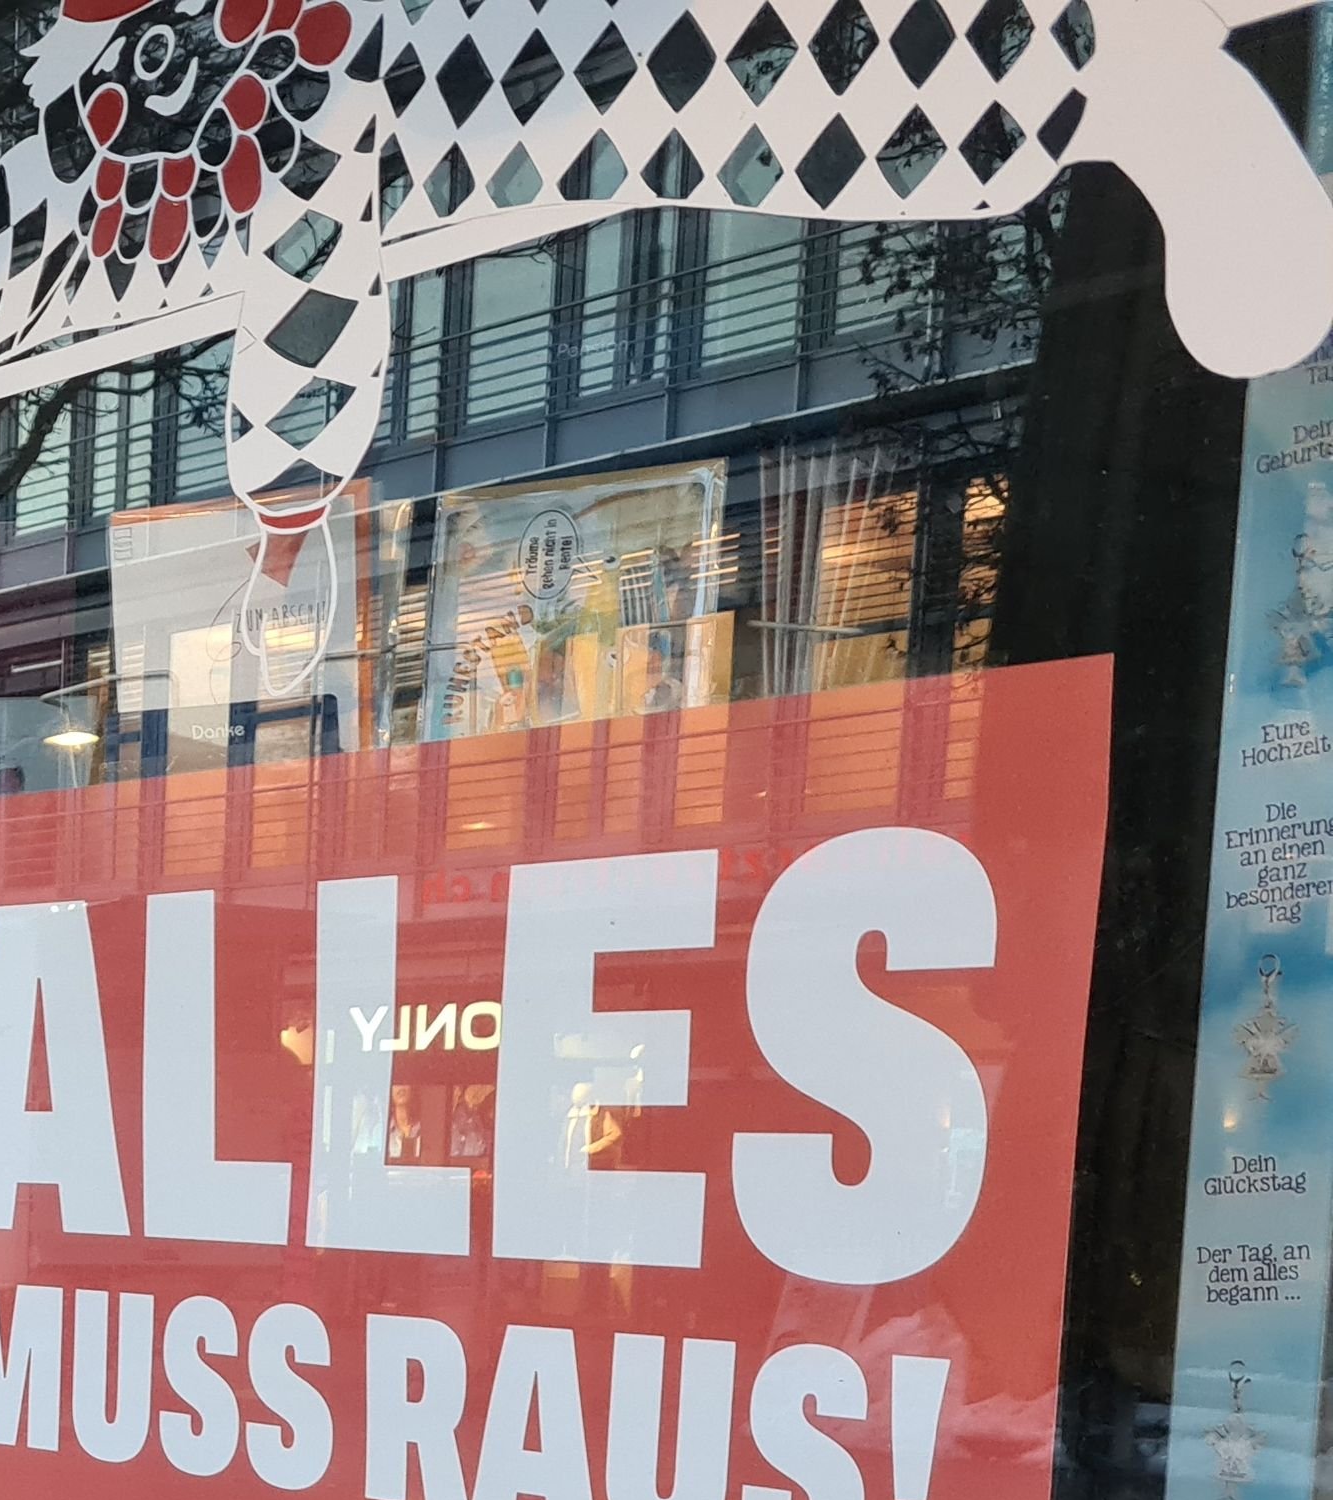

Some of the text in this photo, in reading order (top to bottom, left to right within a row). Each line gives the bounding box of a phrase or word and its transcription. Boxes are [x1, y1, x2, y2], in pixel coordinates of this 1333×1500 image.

[192, 723, 245, 740] Danke
[1262, 720, 1310, 743] Eure
[1241, 736, 1331, 767] Hochzeit
[1266, 803, 1297, 822] Die
[1240, 839, 1325, 866] an einen
[1258, 864, 1307, 888] ganz
[1266, 904, 1301, 924] Tag
[1232, 1155, 1276, 1174] Dein
[1204, 1173, 1306, 1196] Glückstag
[1197, 1246, 1232, 1264] Der
[1284, 1243, 1311, 1260] an
[1209, 1263, 1299, 1282] dem alles
[1206, 1285, 1279, 1306] begann
